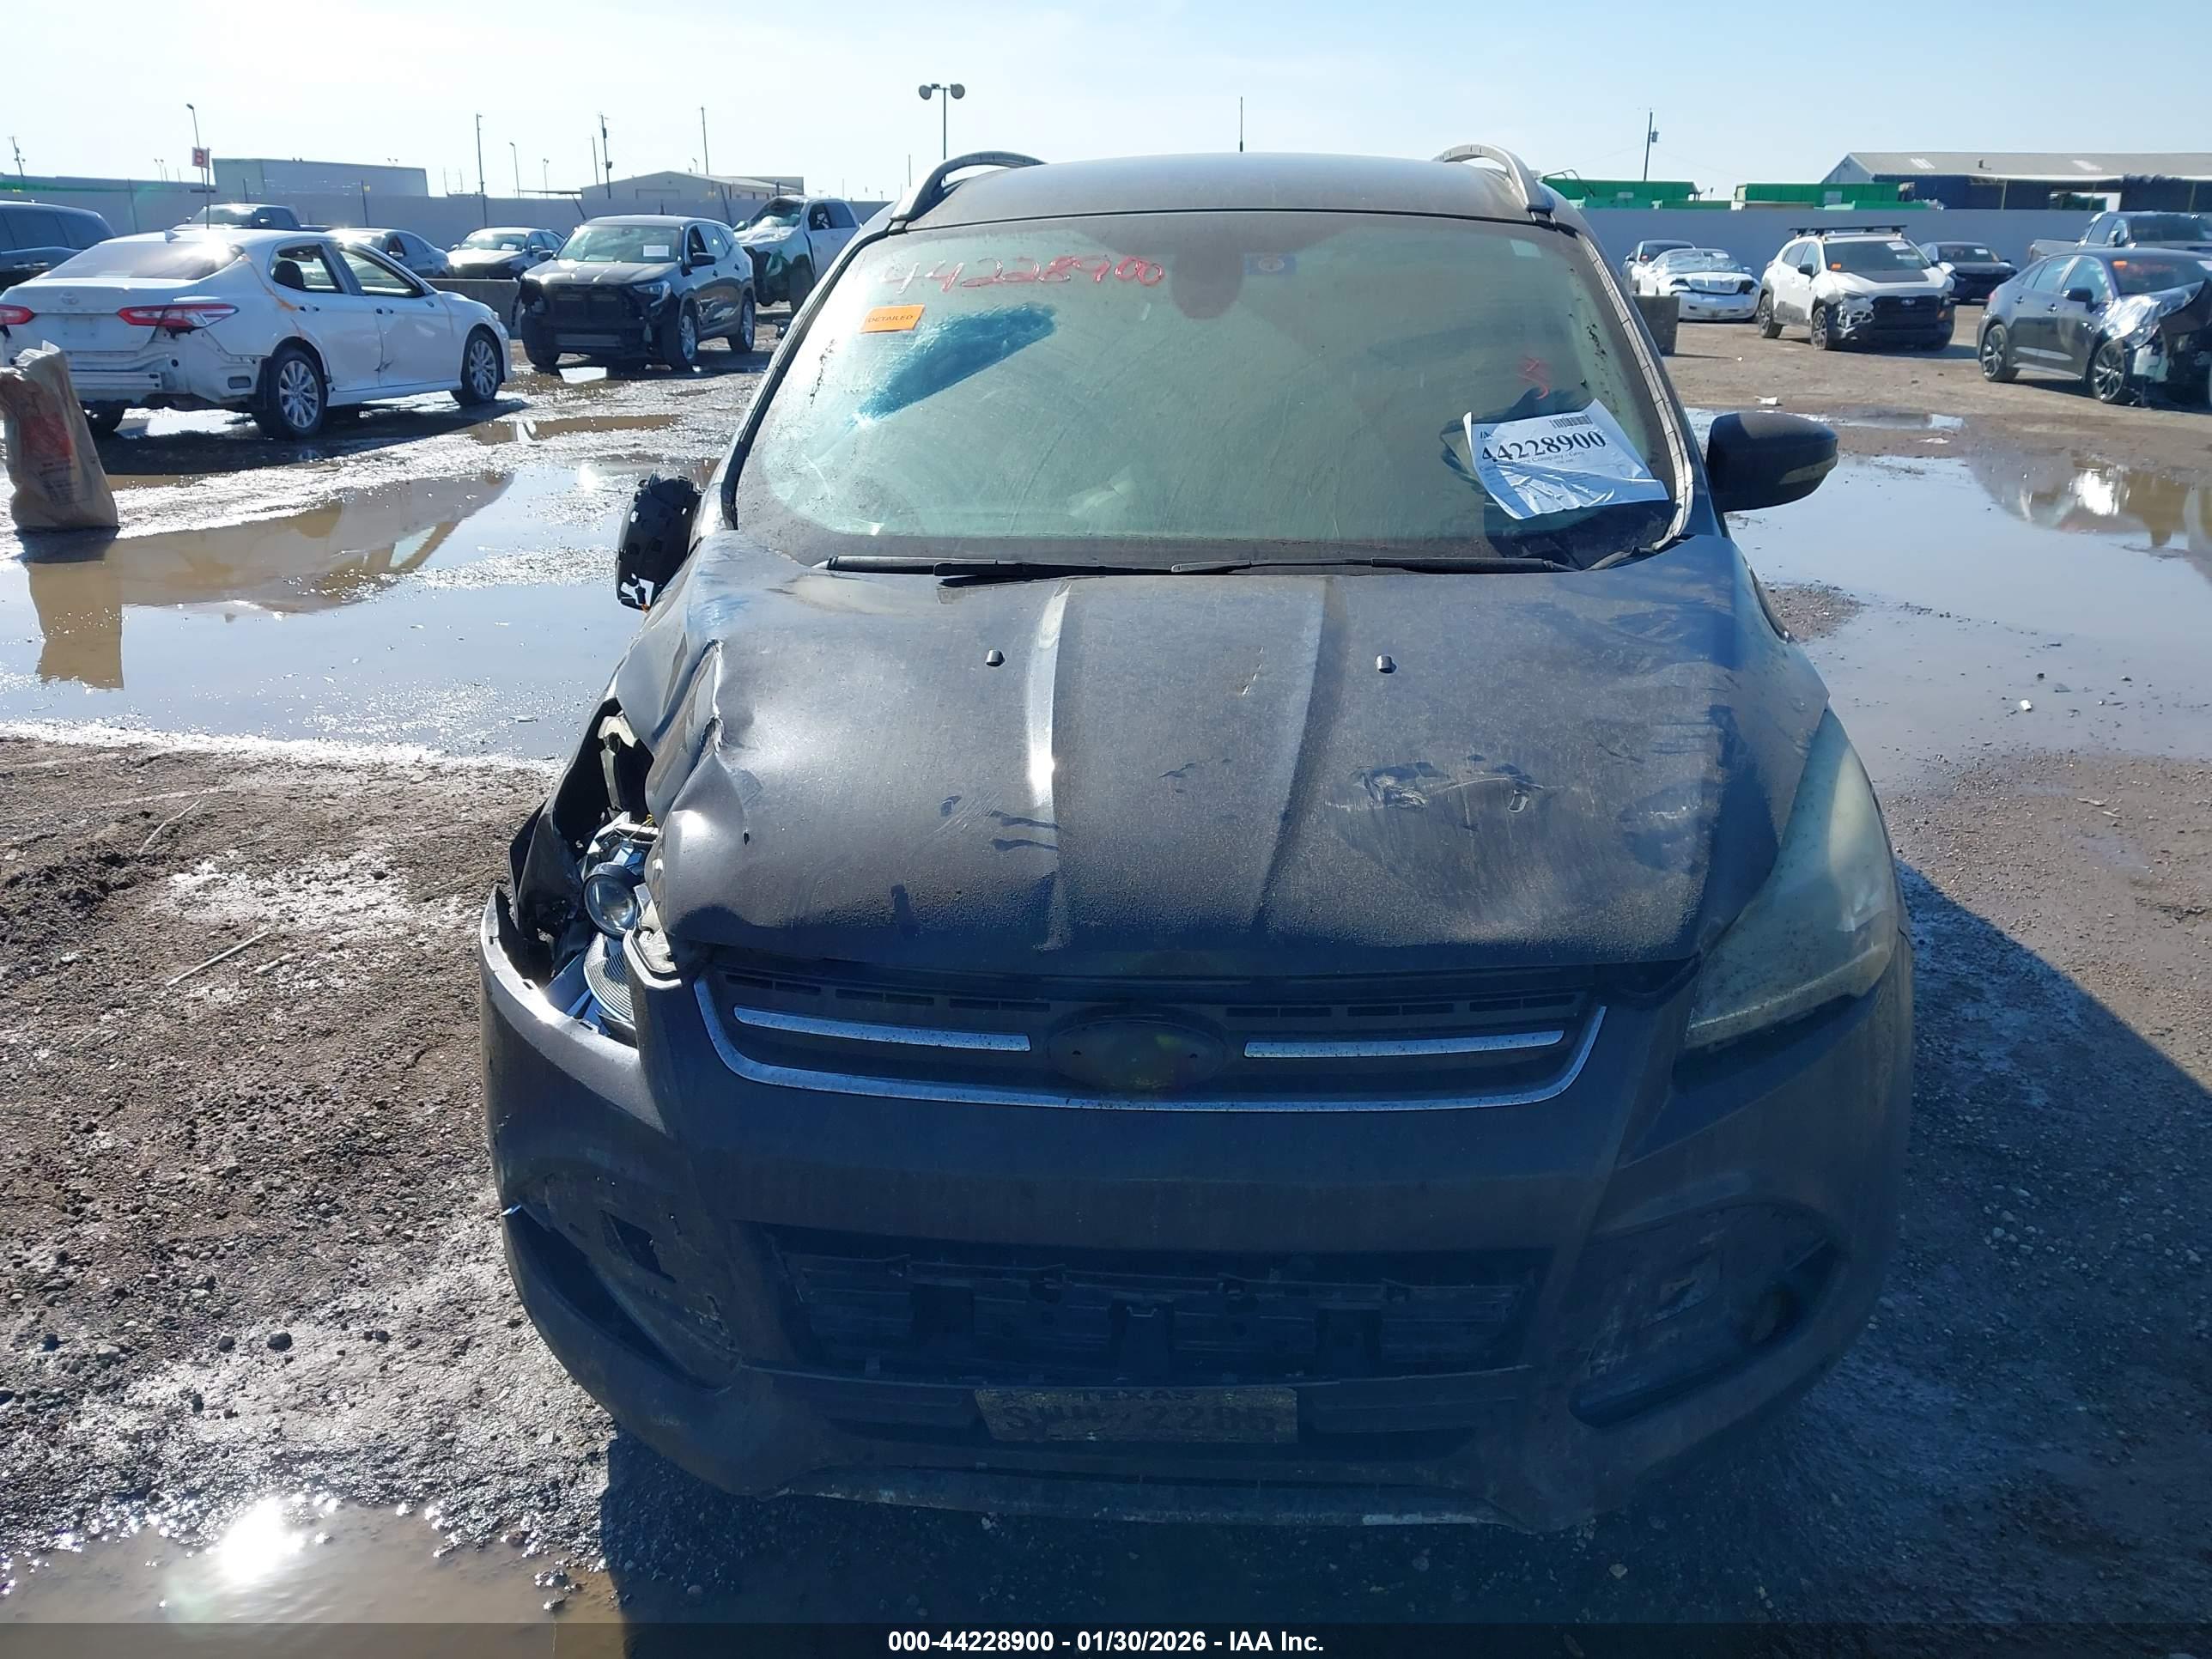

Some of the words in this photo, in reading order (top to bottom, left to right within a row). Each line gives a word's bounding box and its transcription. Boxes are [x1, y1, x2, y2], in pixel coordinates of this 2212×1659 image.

[194, 149, 204, 165] B
[879, 255, 1165, 295] 44228900
[1481, 430, 1607, 462] 44228900
